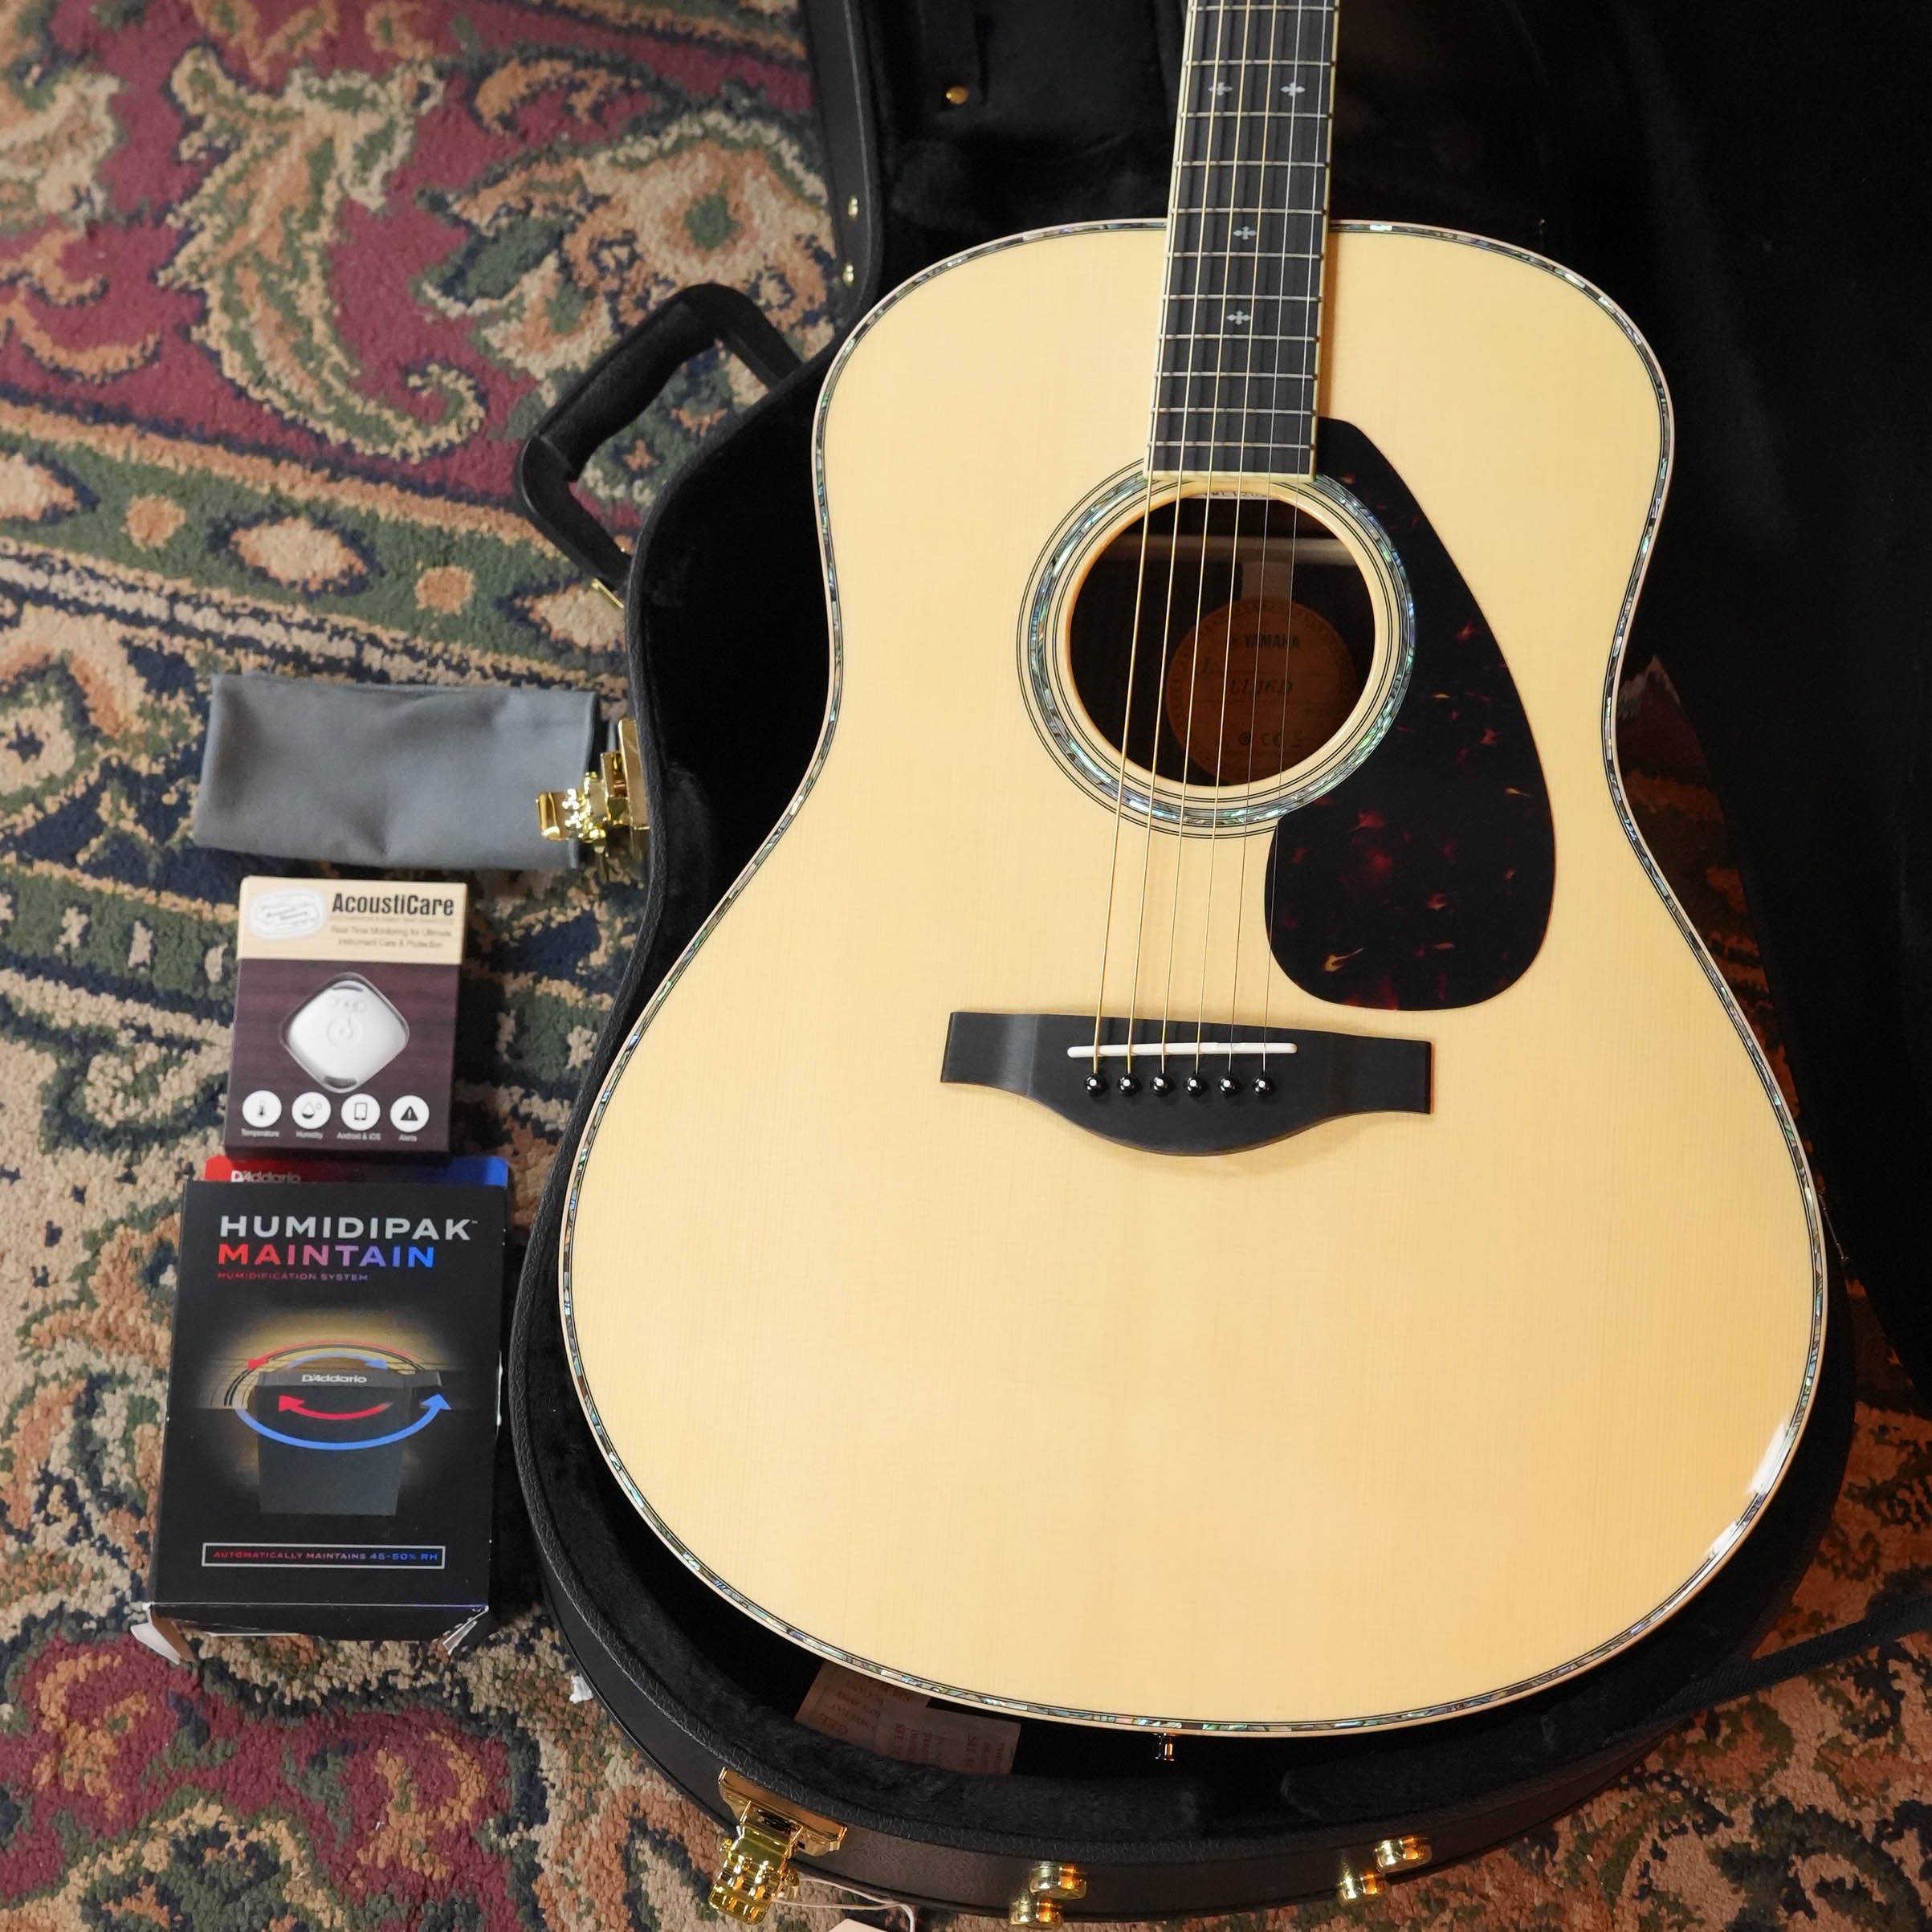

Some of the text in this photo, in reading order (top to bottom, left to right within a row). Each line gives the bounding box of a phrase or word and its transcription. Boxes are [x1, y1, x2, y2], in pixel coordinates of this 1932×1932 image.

[1245, 634, 1300, 649] YAMAHA
[331, 892, 454, 916] AcoustiCare
[370, 927, 409, 937] Monitoring
[338, 938, 377, 947] Instrument
[378, 939, 397, 948] Care
[406, 940, 443, 948] Protection
[241, 1129, 279, 1139] Temperature
[296, 1130, 323, 1139] Humidity
[336, 1131, 361, 1140] Android
[219, 1215, 472, 1241] HUMIDIPAK
[218, 1244, 435, 1268] MAINTAIN
[217, 1272, 369, 1282] HUMIDIFICATION SYSTEM
[213, 1551, 438, 1561] AUTOMATICALLY MAINTAINS 45-50% RH
